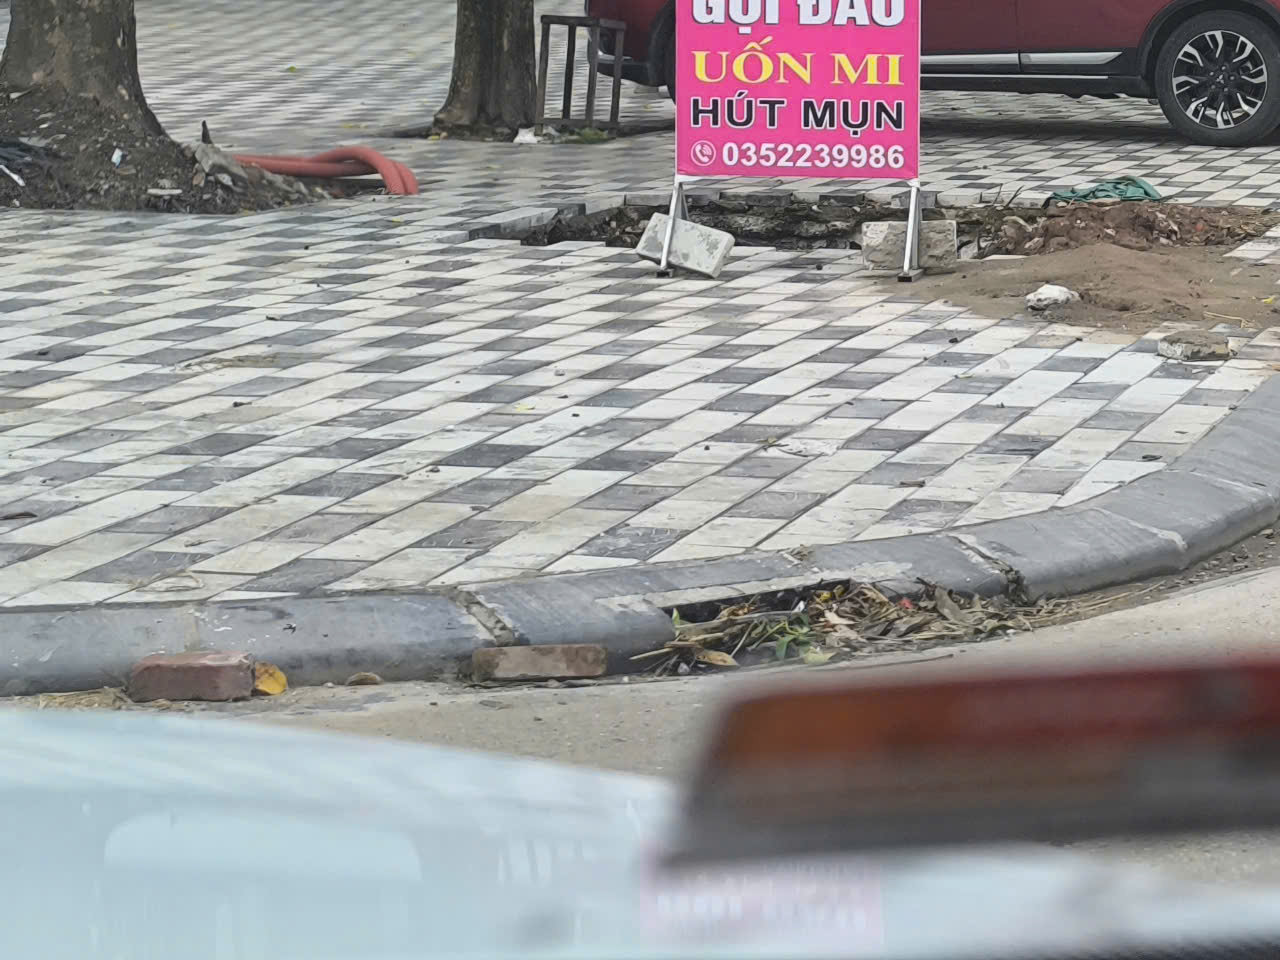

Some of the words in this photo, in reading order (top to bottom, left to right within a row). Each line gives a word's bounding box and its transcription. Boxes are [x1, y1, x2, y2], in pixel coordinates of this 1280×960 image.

[691, 36, 814, 84] UỐN
[830, 53, 904, 85] MI
[690, 90, 786, 128] HÚT
[801, 99, 904, 137] MỤN
[722, 142, 904, 169] 0352239986
